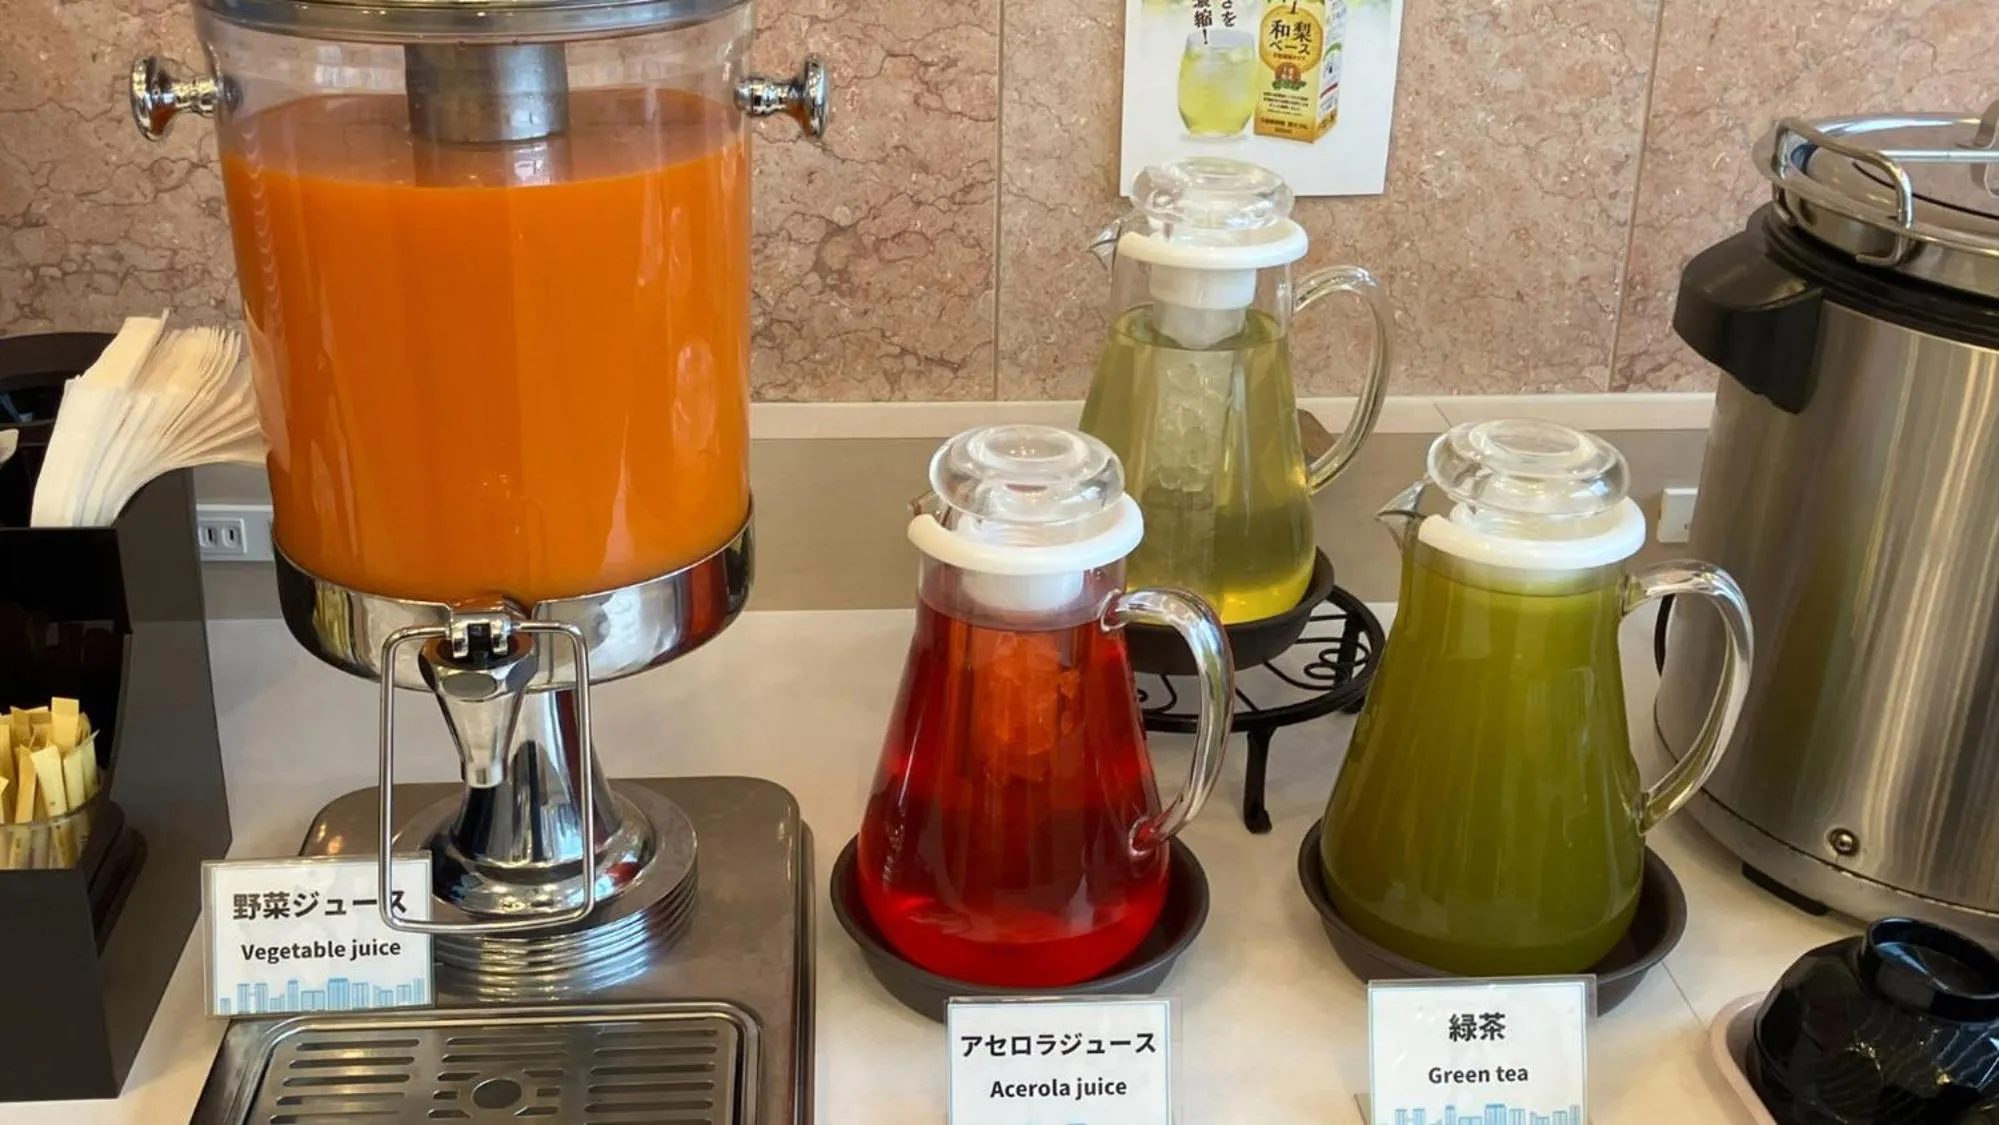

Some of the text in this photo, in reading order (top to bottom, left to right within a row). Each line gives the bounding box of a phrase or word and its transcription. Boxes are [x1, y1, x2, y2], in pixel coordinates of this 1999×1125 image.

[1269, 19, 1312, 43] 和梨
[1268, 38, 1311, 55] ベース
[232, 889, 408, 921] 野菜ジュース
[241, 938, 401, 965] Vegetable juice
[1449, 1012, 1506, 1042] 緑茶
[961, 1032, 1156, 1057] アセロラジュース
[1428, 1065, 1528, 1084] Green tea
[990, 1077, 1127, 1101] Acerola juice
